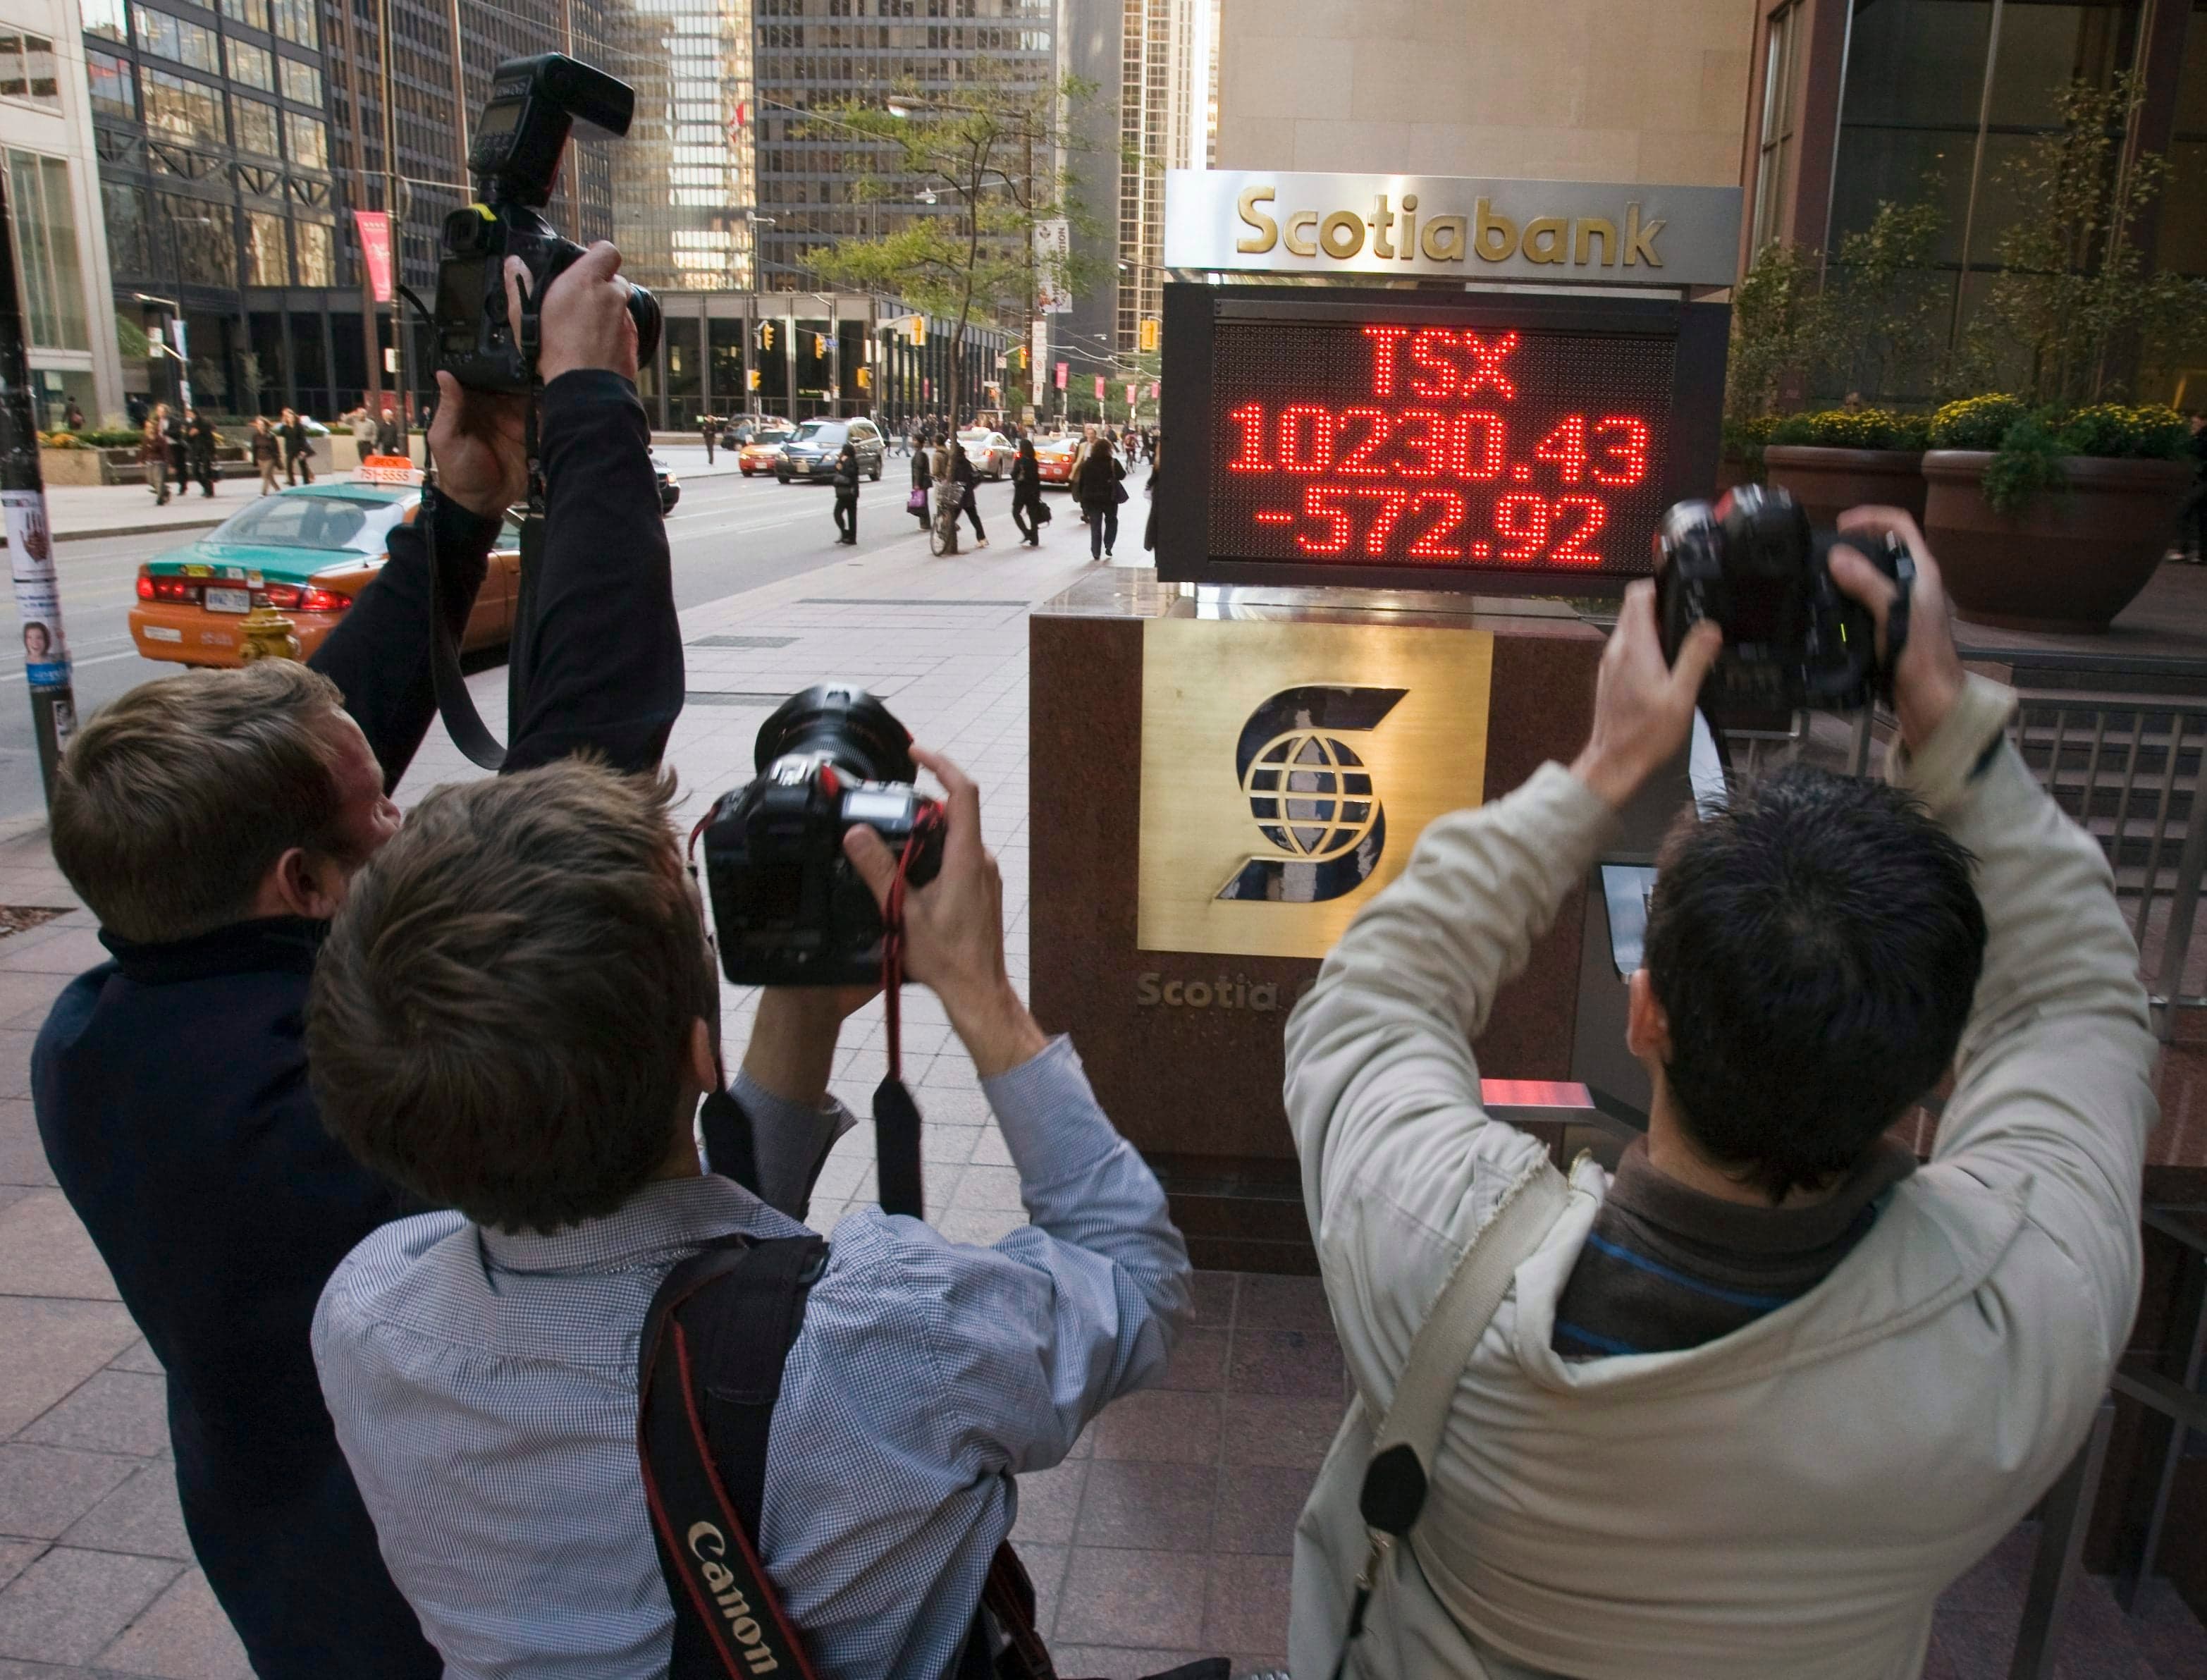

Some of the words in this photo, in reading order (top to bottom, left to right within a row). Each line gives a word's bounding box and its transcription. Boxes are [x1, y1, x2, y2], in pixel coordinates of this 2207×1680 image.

[1236, 185, 1666, 267] Scotiabank
[1363, 326, 1518, 400] TSX
[1229, 403, 1650, 486] 10230.43
[1255, 485, 1606, 563] -572.92
[1137, 973, 1278, 1012] Scotia
[688, 1521, 778, 1674] Canon
